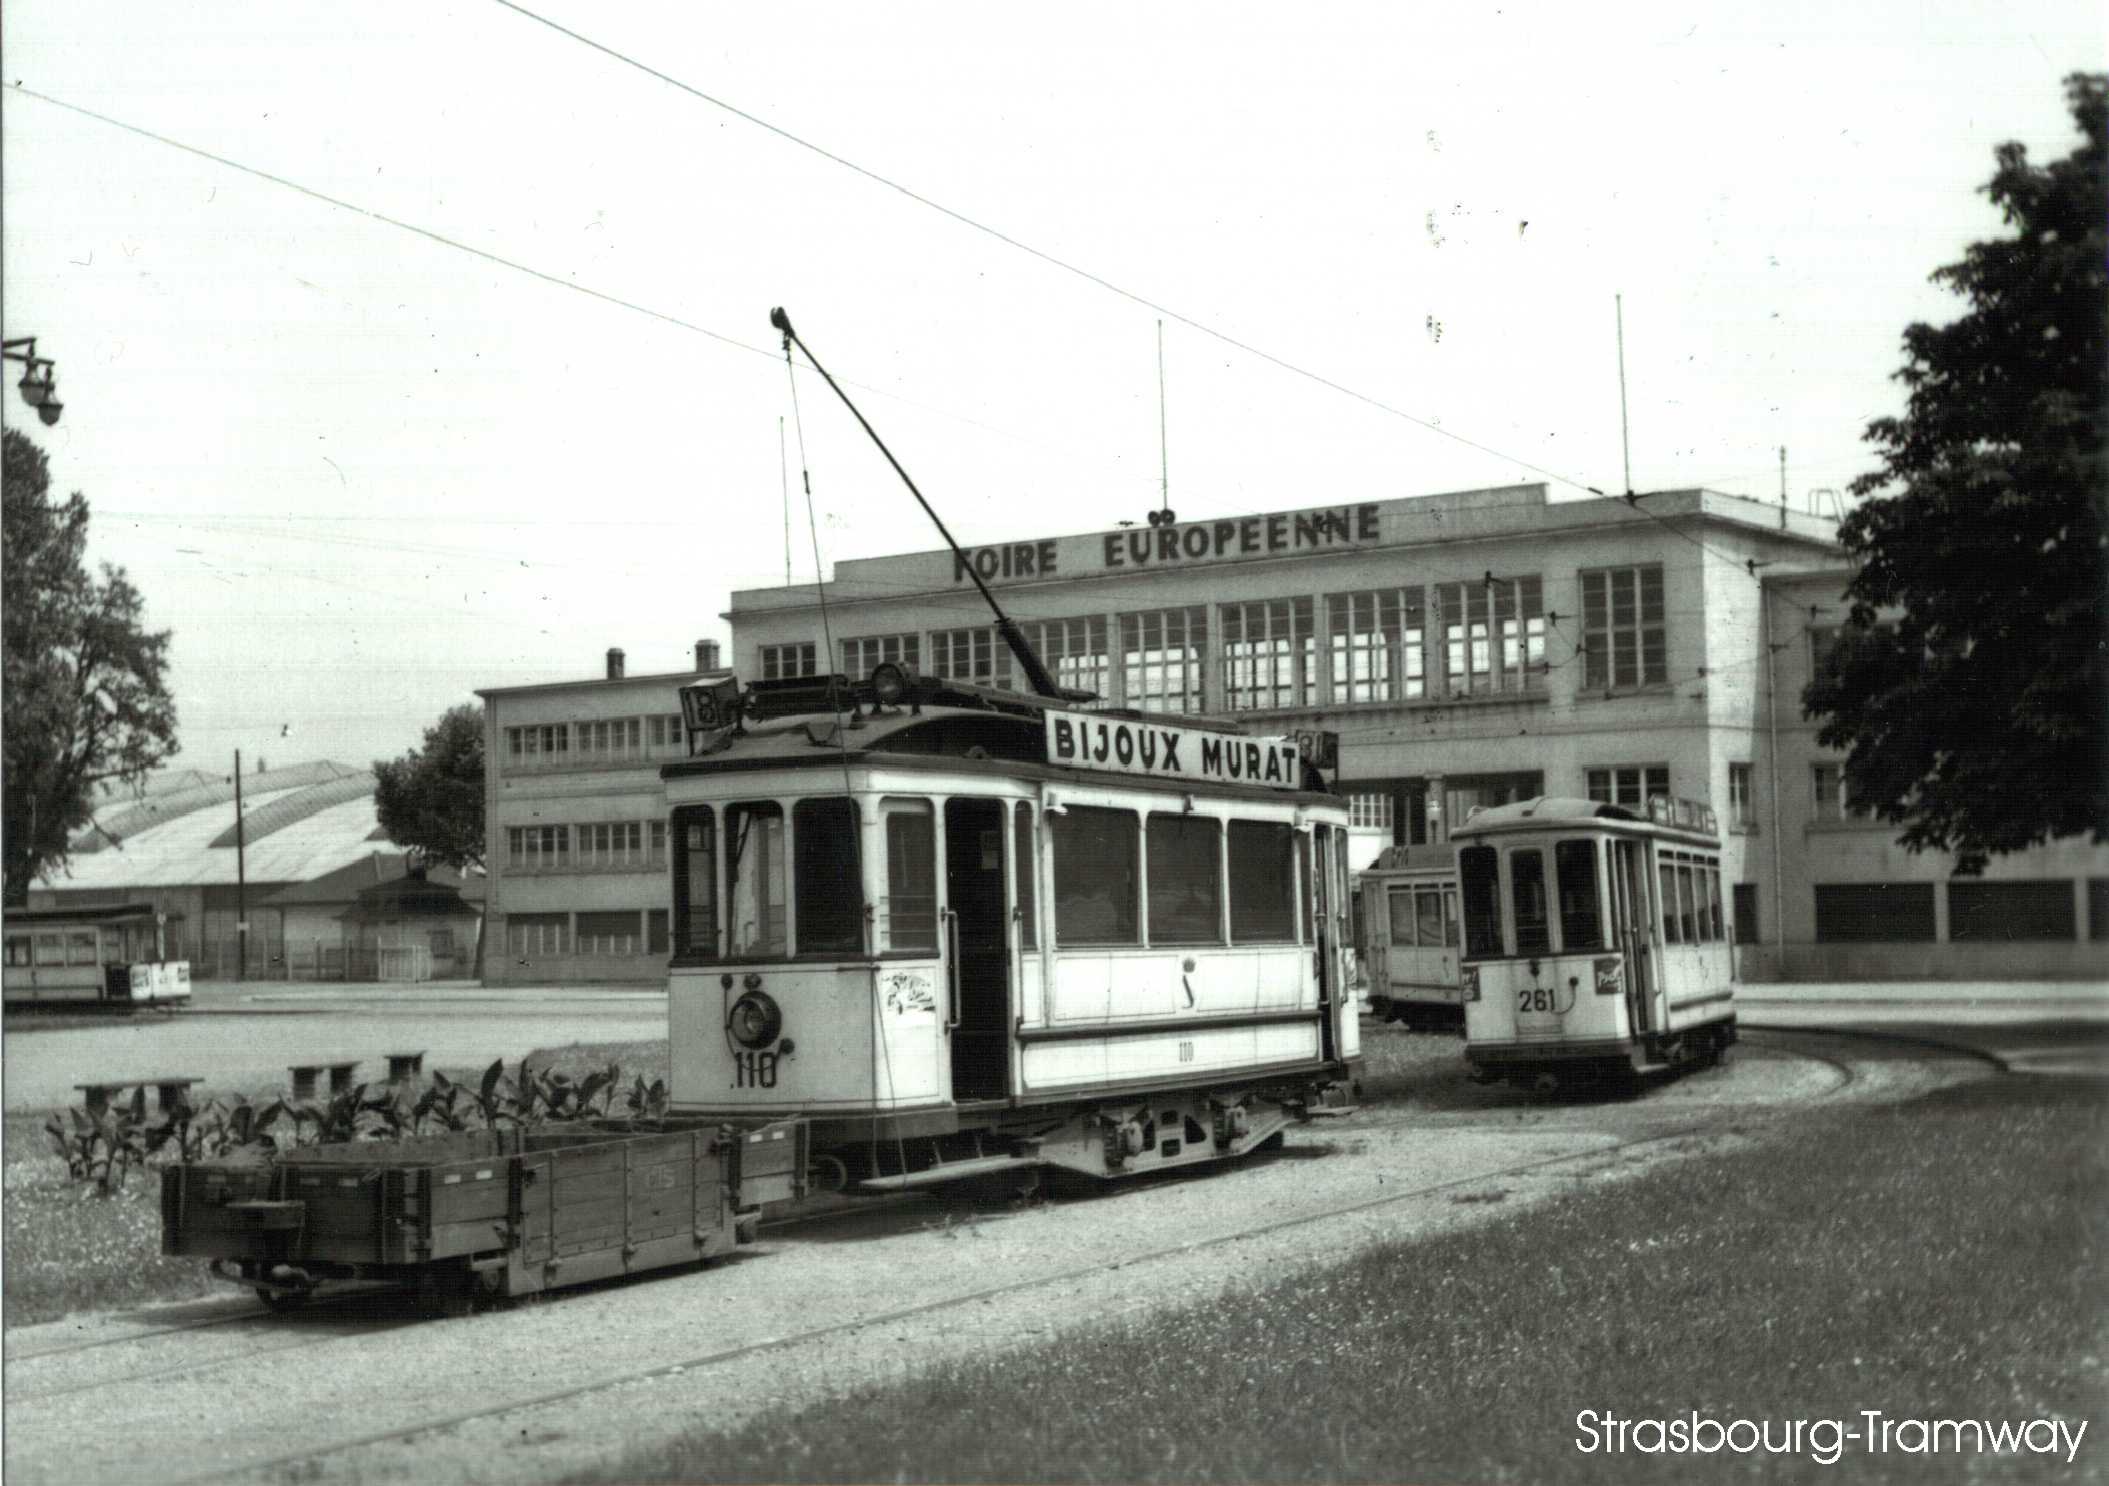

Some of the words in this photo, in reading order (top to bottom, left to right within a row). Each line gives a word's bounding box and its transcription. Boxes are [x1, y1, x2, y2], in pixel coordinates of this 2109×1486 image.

[953, 540, 1057, 582] FOIRE
[1104, 503, 1380, 567] EUROPEENNE
[1054, 718, 1182, 772] BIJOUX
[1202, 737, 1296, 783] MURAT
[1519, 989, 1555, 1012] 261
[735, 1051, 777, 1089] 110
